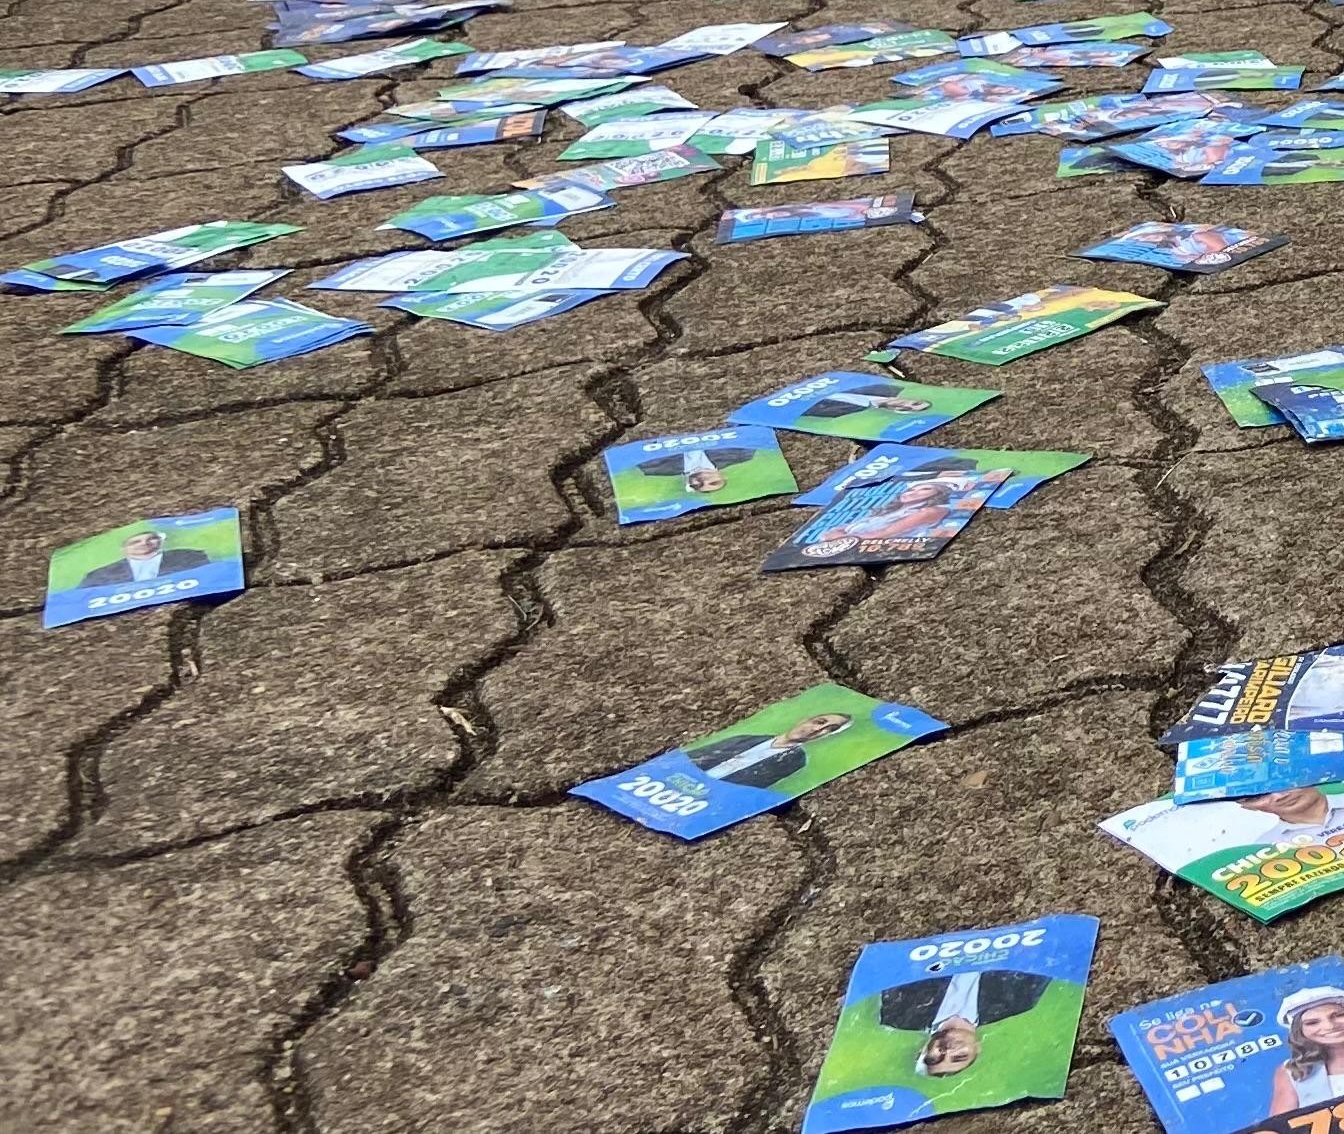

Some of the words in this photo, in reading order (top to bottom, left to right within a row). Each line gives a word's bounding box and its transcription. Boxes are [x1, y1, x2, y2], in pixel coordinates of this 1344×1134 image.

[643, 431, 737, 452] 20020
[88, 576, 200, 610] 20020
[617, 773, 709, 817] 20020
[1254, 876, 1301, 903] SEMPRE
[909, 927, 1048, 962] 20020
[1139, 1017, 1162, 1031] Se
[1165, 1005, 1196, 1023] liga
[1199, 999, 1223, 1012] na
[1147, 1003, 1240, 1046] COLI
[1155, 1023, 1245, 1061] NHA
[1168, 1035, 1281, 1081] 10789
